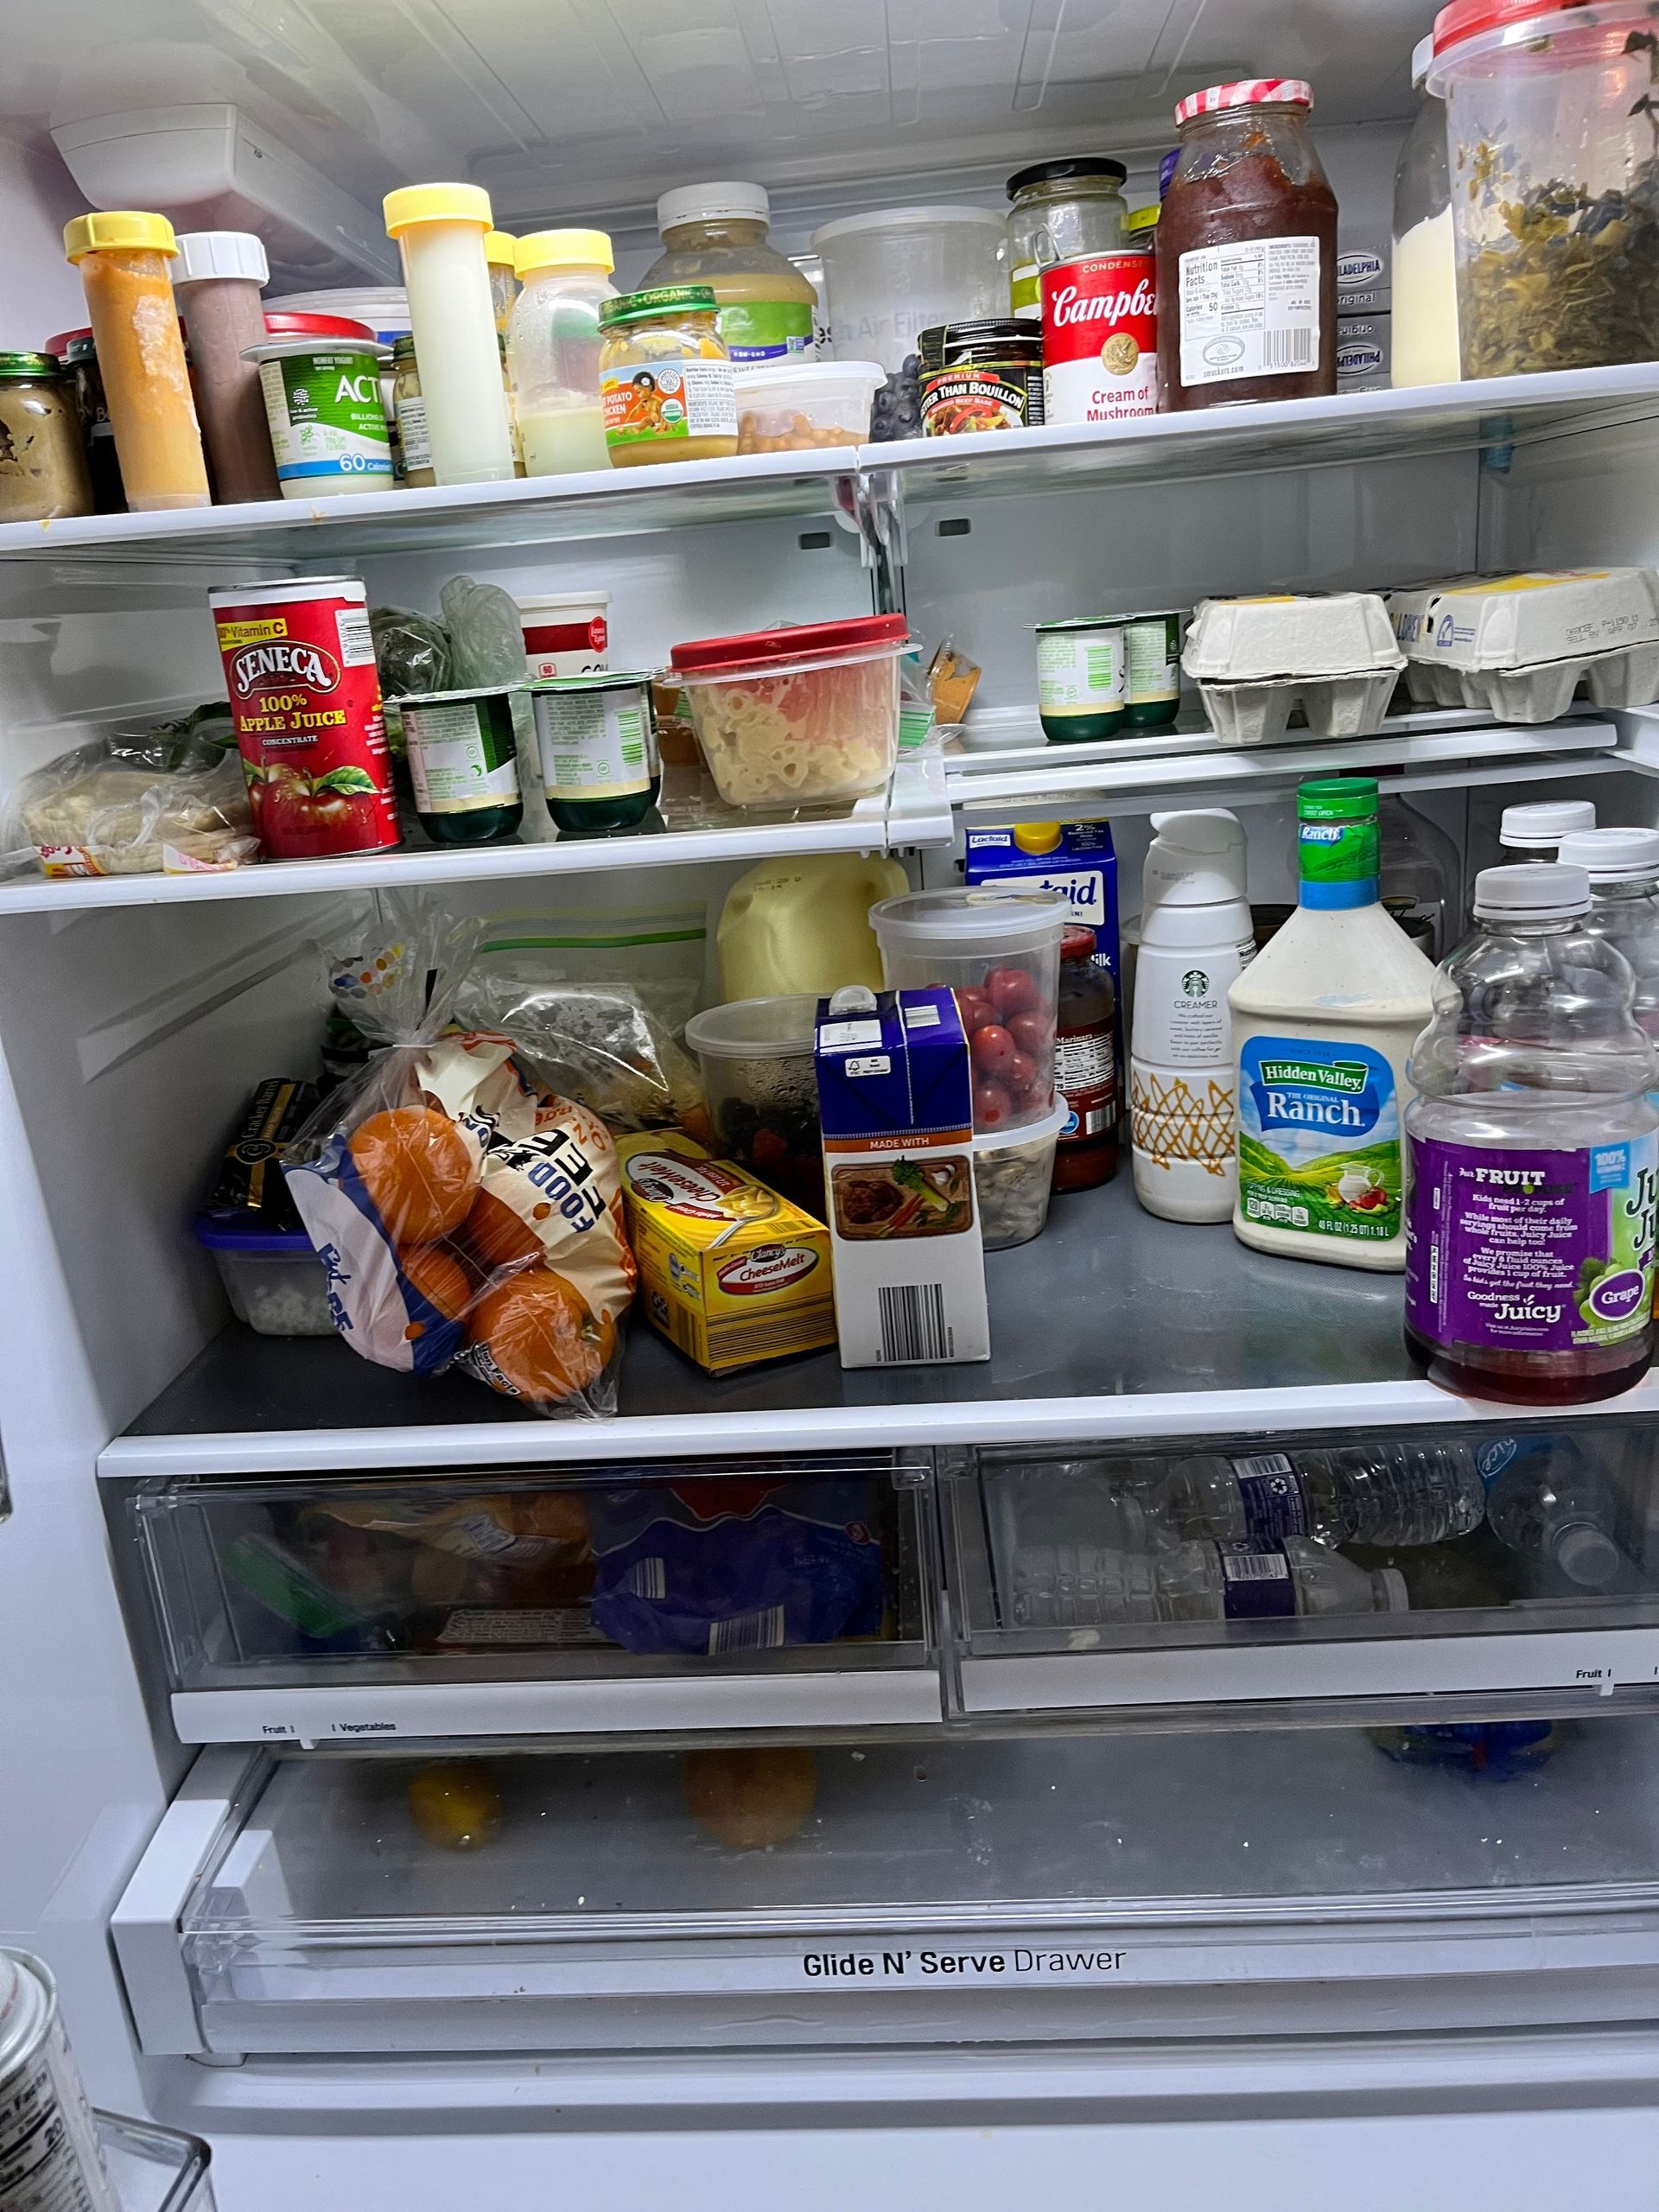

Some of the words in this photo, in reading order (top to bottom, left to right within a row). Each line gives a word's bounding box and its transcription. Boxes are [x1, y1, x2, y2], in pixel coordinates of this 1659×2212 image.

[1083, 260, 1149, 273] CONDENSE
[1185, 261, 1218, 276] Nutrition
[1185, 275, 1205, 288] Facts
[643, 290, 695, 304] ORGANIC
[1052, 278, 1157, 327] Campbe
[1185, 304, 1203, 313] Calories
[1209, 302, 1218, 311] 50
[1337, 324, 1374, 334] origina
[937, 372, 981, 385] PREMIUM
[1203, 365, 1244, 378] smuckers.com
[334, 374, 383, 404] ACT
[938, 383, 967, 399] THAN
[969, 381, 1024, 409] BOUILLON
[1091, 390, 1135, 404] Cream
[1137, 386, 1148, 400] of
[607, 391, 633, 406] POTATO
[974, 397, 994, 406] BASE
[1087, 405, 1154, 422] Mushroom
[340, 453, 365, 472] 60
[232, 624, 271, 638] Vitamin
[272, 621, 284, 635] C
[235, 646, 333, 693] SENECA
[258, 693, 308, 713] 100%
[239, 715, 286, 733] APPLE
[289, 709, 346, 729] JUICE
[262, 734, 319, 746] CONCENTRATE
[971, 835, 1008, 843] Lactaid
[1090, 952, 1111, 967] ilk
[1173, 1000, 1217, 1009] CREAMER
[1056, 1033, 1092, 1045] Marinara
[1264, 1065, 1317, 1082] Hidden
[1287, 1091, 1302, 1100] THE
[1302, 1093, 1339, 1103] ORIGINAL
[869, 1140, 899, 1149] MADE
[901, 1137, 929, 1147] WITH
[1595, 1148, 1626, 1166] 100%
[637, 1161, 721, 1202] CheeseMelt
[1475, 1167, 1546, 1186] FRUIT
[528, 1162, 595, 1233] FOOD
[1271, 1188, 1300, 1198] DRESSING
[1472, 1193, 1492, 1203] Kids
[1531, 1199, 1554, 1208] cups
[1488, 1202, 1510, 1211] fruit
[1510, 1205, 1527, 1213] per
[1527, 1205, 1547, 1214] day.
[1459, 1218, 1496, 1230] servings
[1497, 1223, 1529, 1231] should
[1464, 1211, 1490, 1222] While
[1524, 1217, 1548, 1225] their
[1548, 1217, 1573, 1226] daily
[1325, 1220, 1333, 1231] FL
[1334, 1222, 1342, 1232] OZ
[1384, 1226, 1389, 1236] L
[1464, 1226, 1490, 1236] whole
[1520, 1230, 1547, 1240] Juicy
[1506, 1237, 1527, 1247] help
[750, 1247, 786, 1261] Clancy's
[1472, 1253, 1498, 1263] every
[1506, 1255, 1529, 1264] fluid
[1480, 1246, 1495, 1255] We
[1495, 1249, 1534, 1258] promise
[740, 1253, 806, 1281] CheeseMelt
[1471, 1259, 1495, 1269] Juicy
[1467, 1265, 1505, 1276] provides
[1512, 1270, 1530, 1279] cup
[1489, 1279, 1502, 1287] get
[1516, 1281, 1535, 1289] fruit
[1535, 1281, 1553, 1290] they
[1466, 1291, 1521, 1301] Goodness
[1601, 1285, 1640, 1305] Grape
[1494, 1296, 1561, 1323] Juicy
[1575, 1669, 1602, 1679] Fruit
[262, 1725, 287, 1733] Fruit
[340, 1722, 397, 1732] Vegetables
[803, 1952, 875, 1977] Glide
[920, 1950, 1006, 1975] Serve
[1014, 1948, 1127, 1973] Drawer
